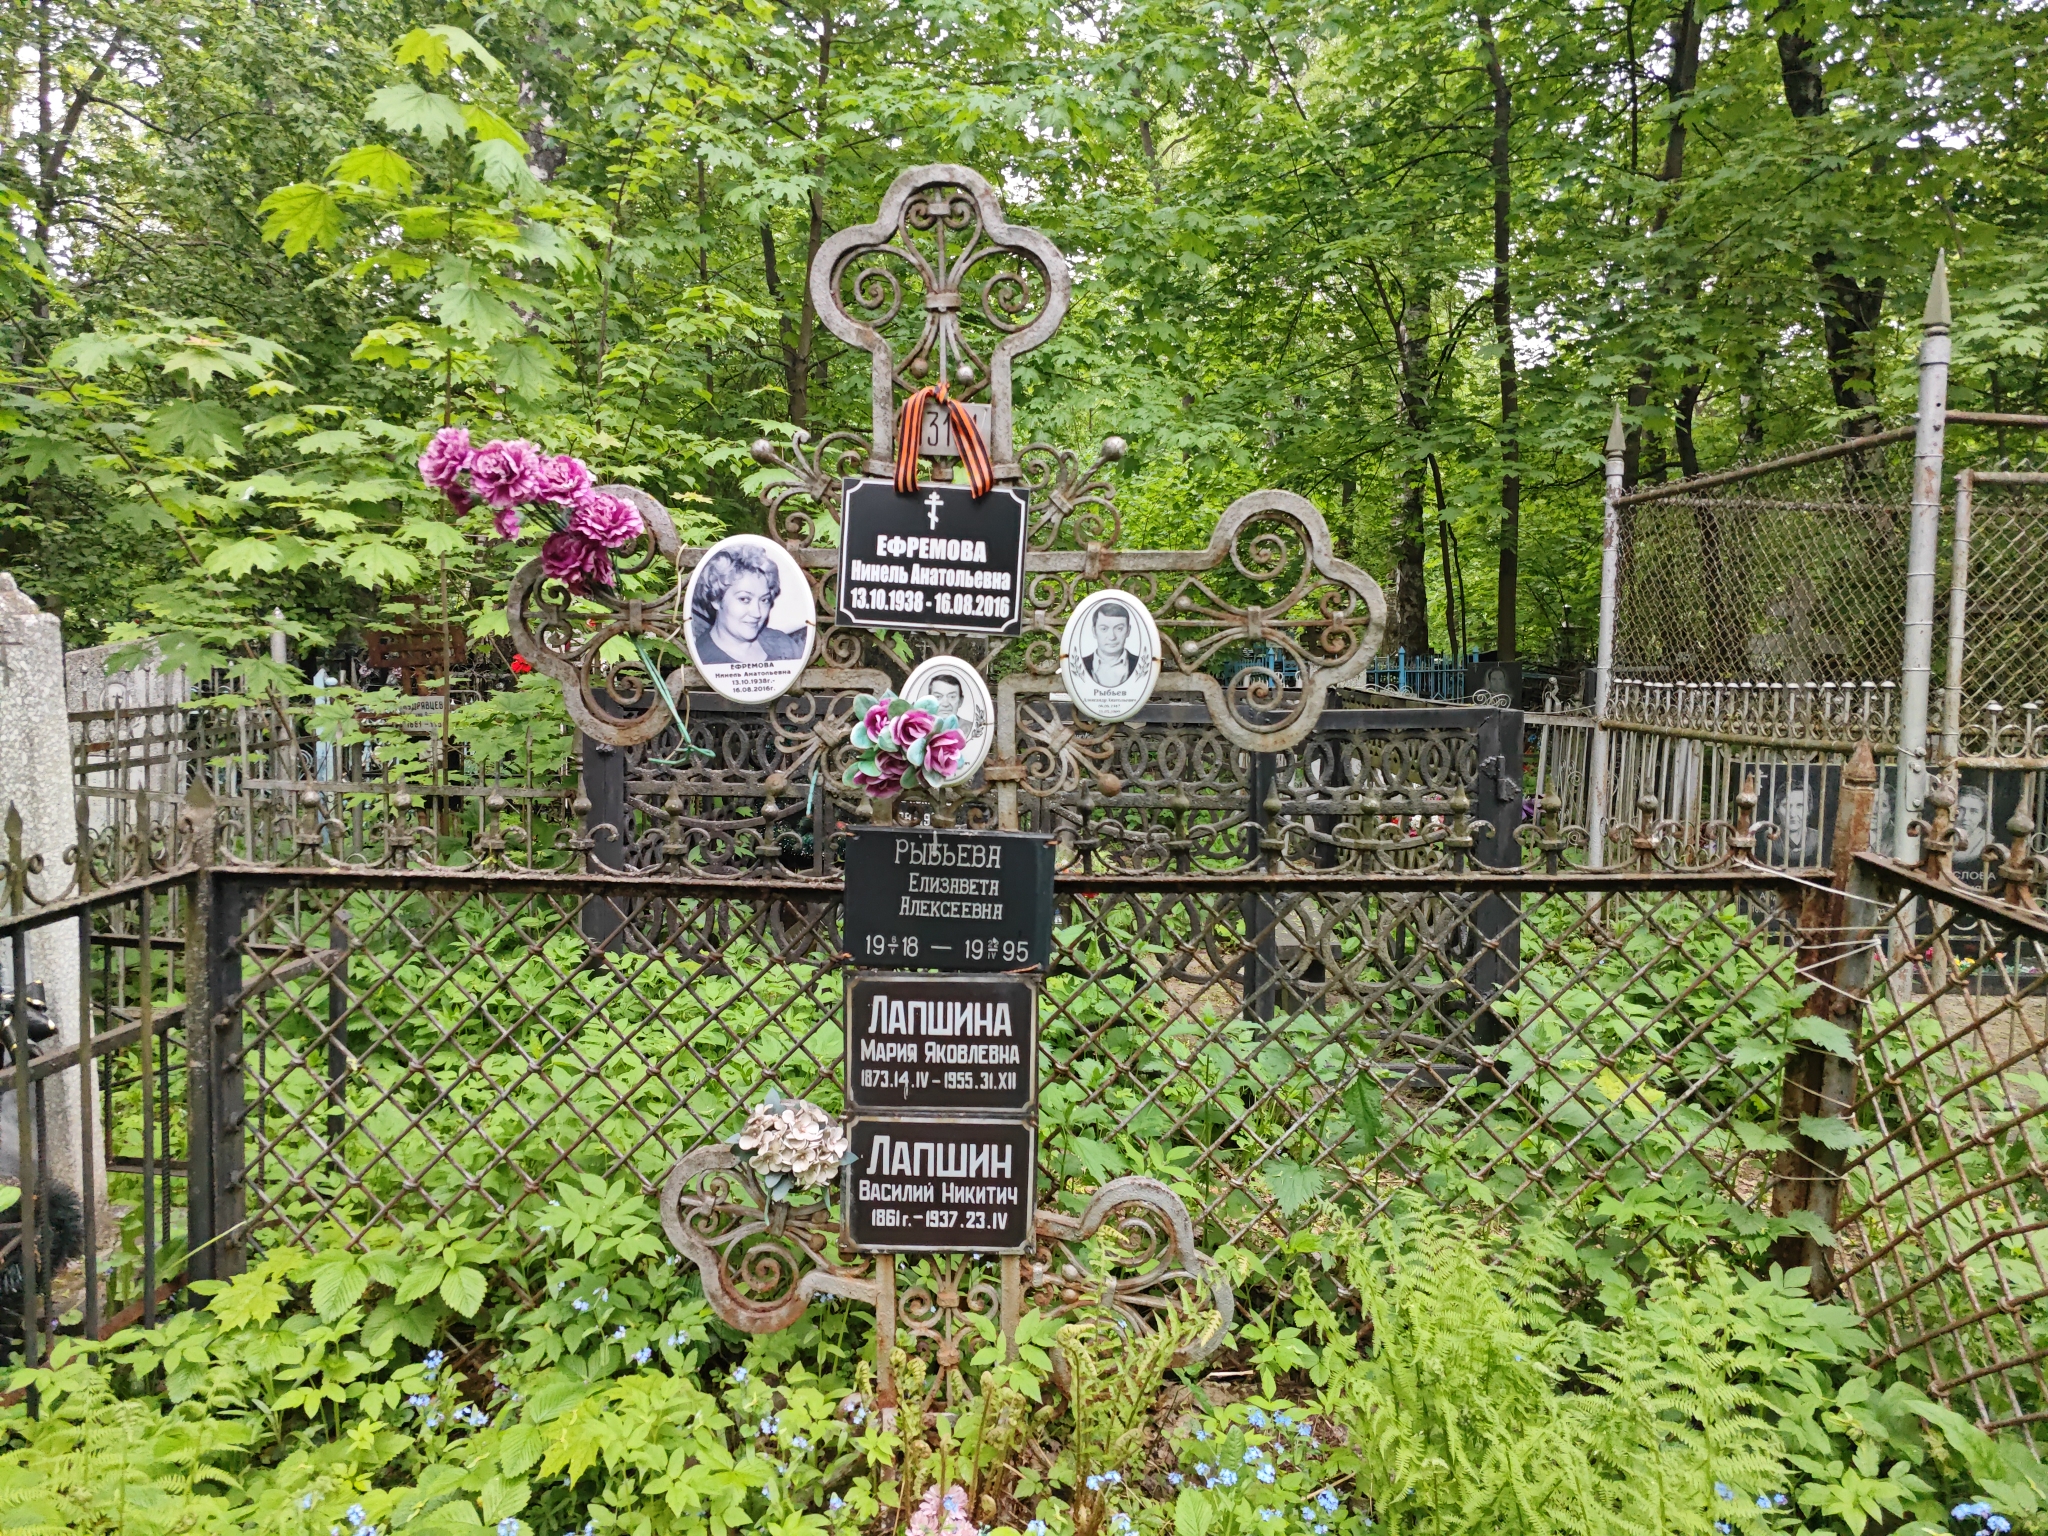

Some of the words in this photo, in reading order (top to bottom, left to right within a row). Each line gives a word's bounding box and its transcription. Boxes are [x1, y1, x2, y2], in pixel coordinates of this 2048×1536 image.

[876, 534, 987, 563] ЕФРЕМОВА
[850, 559, 909, 584] Нинель
[910, 563, 1011, 591] Анатольевна
[850, 587, 924, 613] 13.10.1938
[934, 592, 1010, 618] 16.08.2016
[730, 662, 775, 670] ЕФРЕМОВА
[1093, 688, 1127, 697] Рыбьев
[894, 838, 1002, 869] РЫБЬЕВА
[908, 872, 1000, 897] ЕЛИЗАВЕТА
[898, 896, 1003, 920] АЛЕКСЕЕВНА
[867, 995, 1013, 1037] ЛАПШИНА
[860, 1038, 917, 1064] МАРИЯ
[924, 1041, 1020, 1065] ЯКОВЛЕВНА
[866, 1135, 1013, 1179] ЛАПШИН
[859, 1179, 934, 1204] ВАСИЛИЙ
[941, 1181, 1018, 1205] НИКИТИЧ
